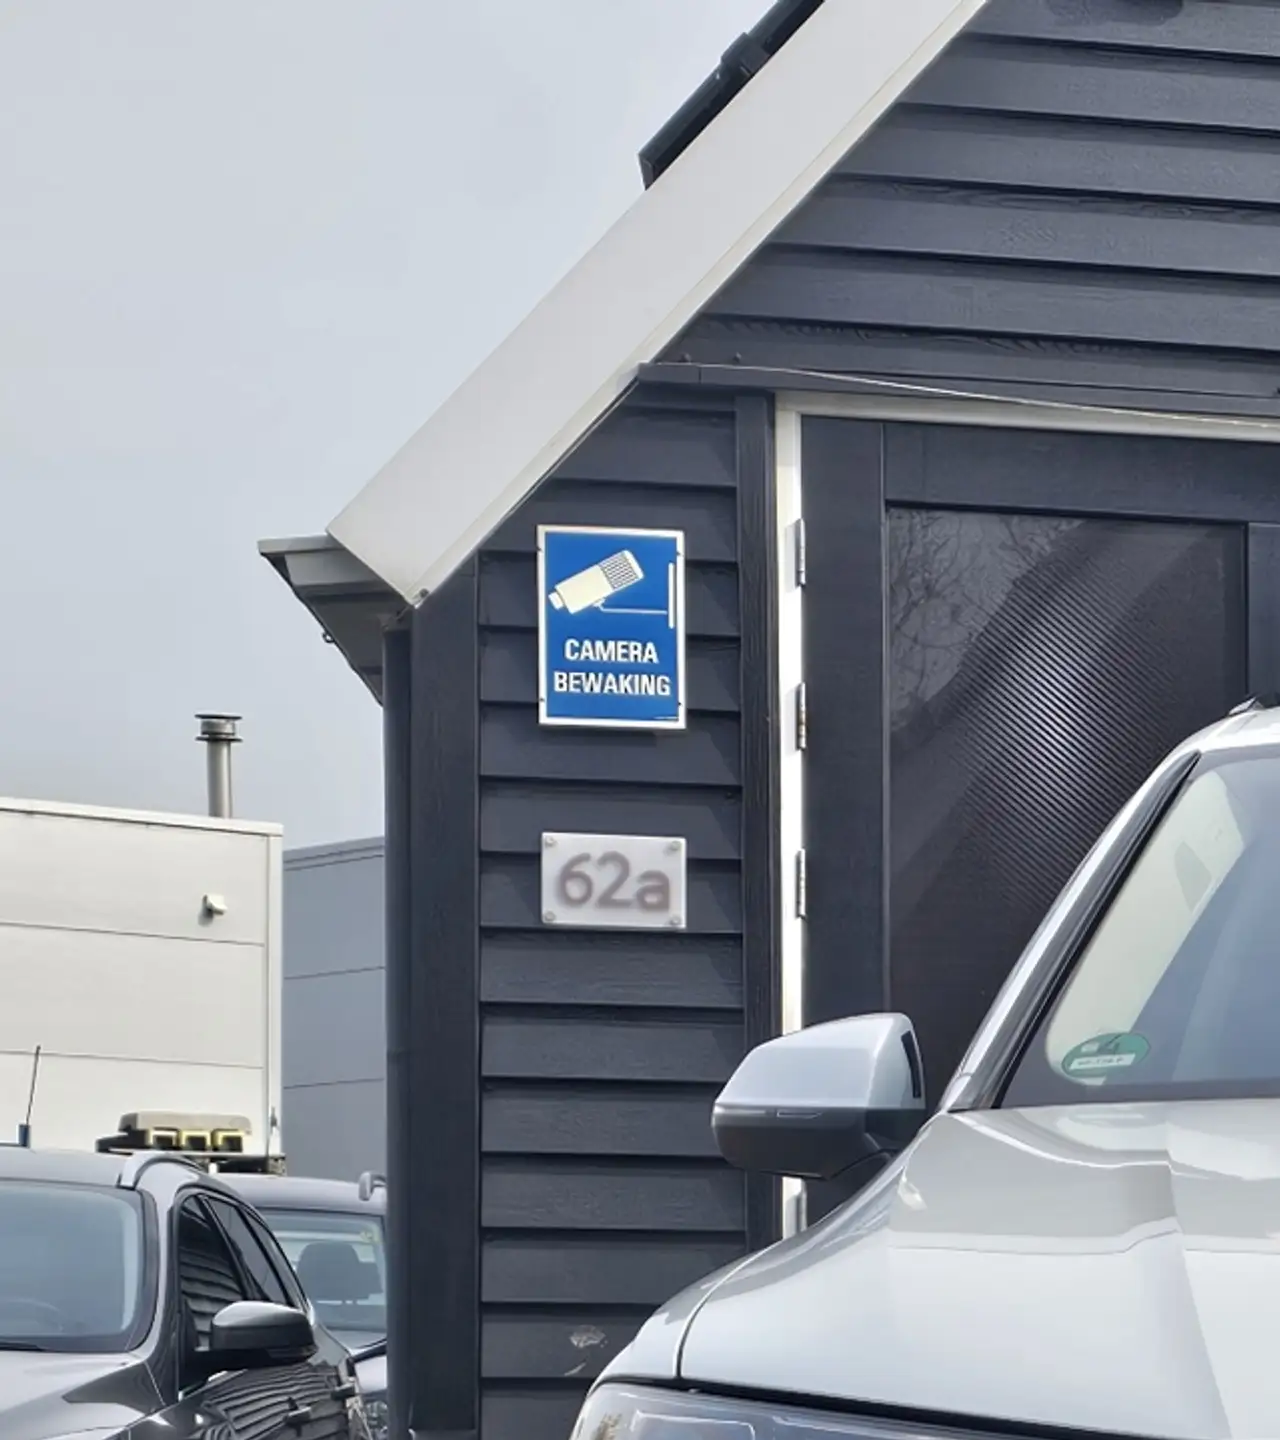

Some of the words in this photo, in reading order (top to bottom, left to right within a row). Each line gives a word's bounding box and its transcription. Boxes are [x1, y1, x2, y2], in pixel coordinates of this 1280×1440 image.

[564, 638, 659, 665] CAMERA
[553, 672, 671, 697] BEWAKING
[556, 850, 671, 911] 62a
